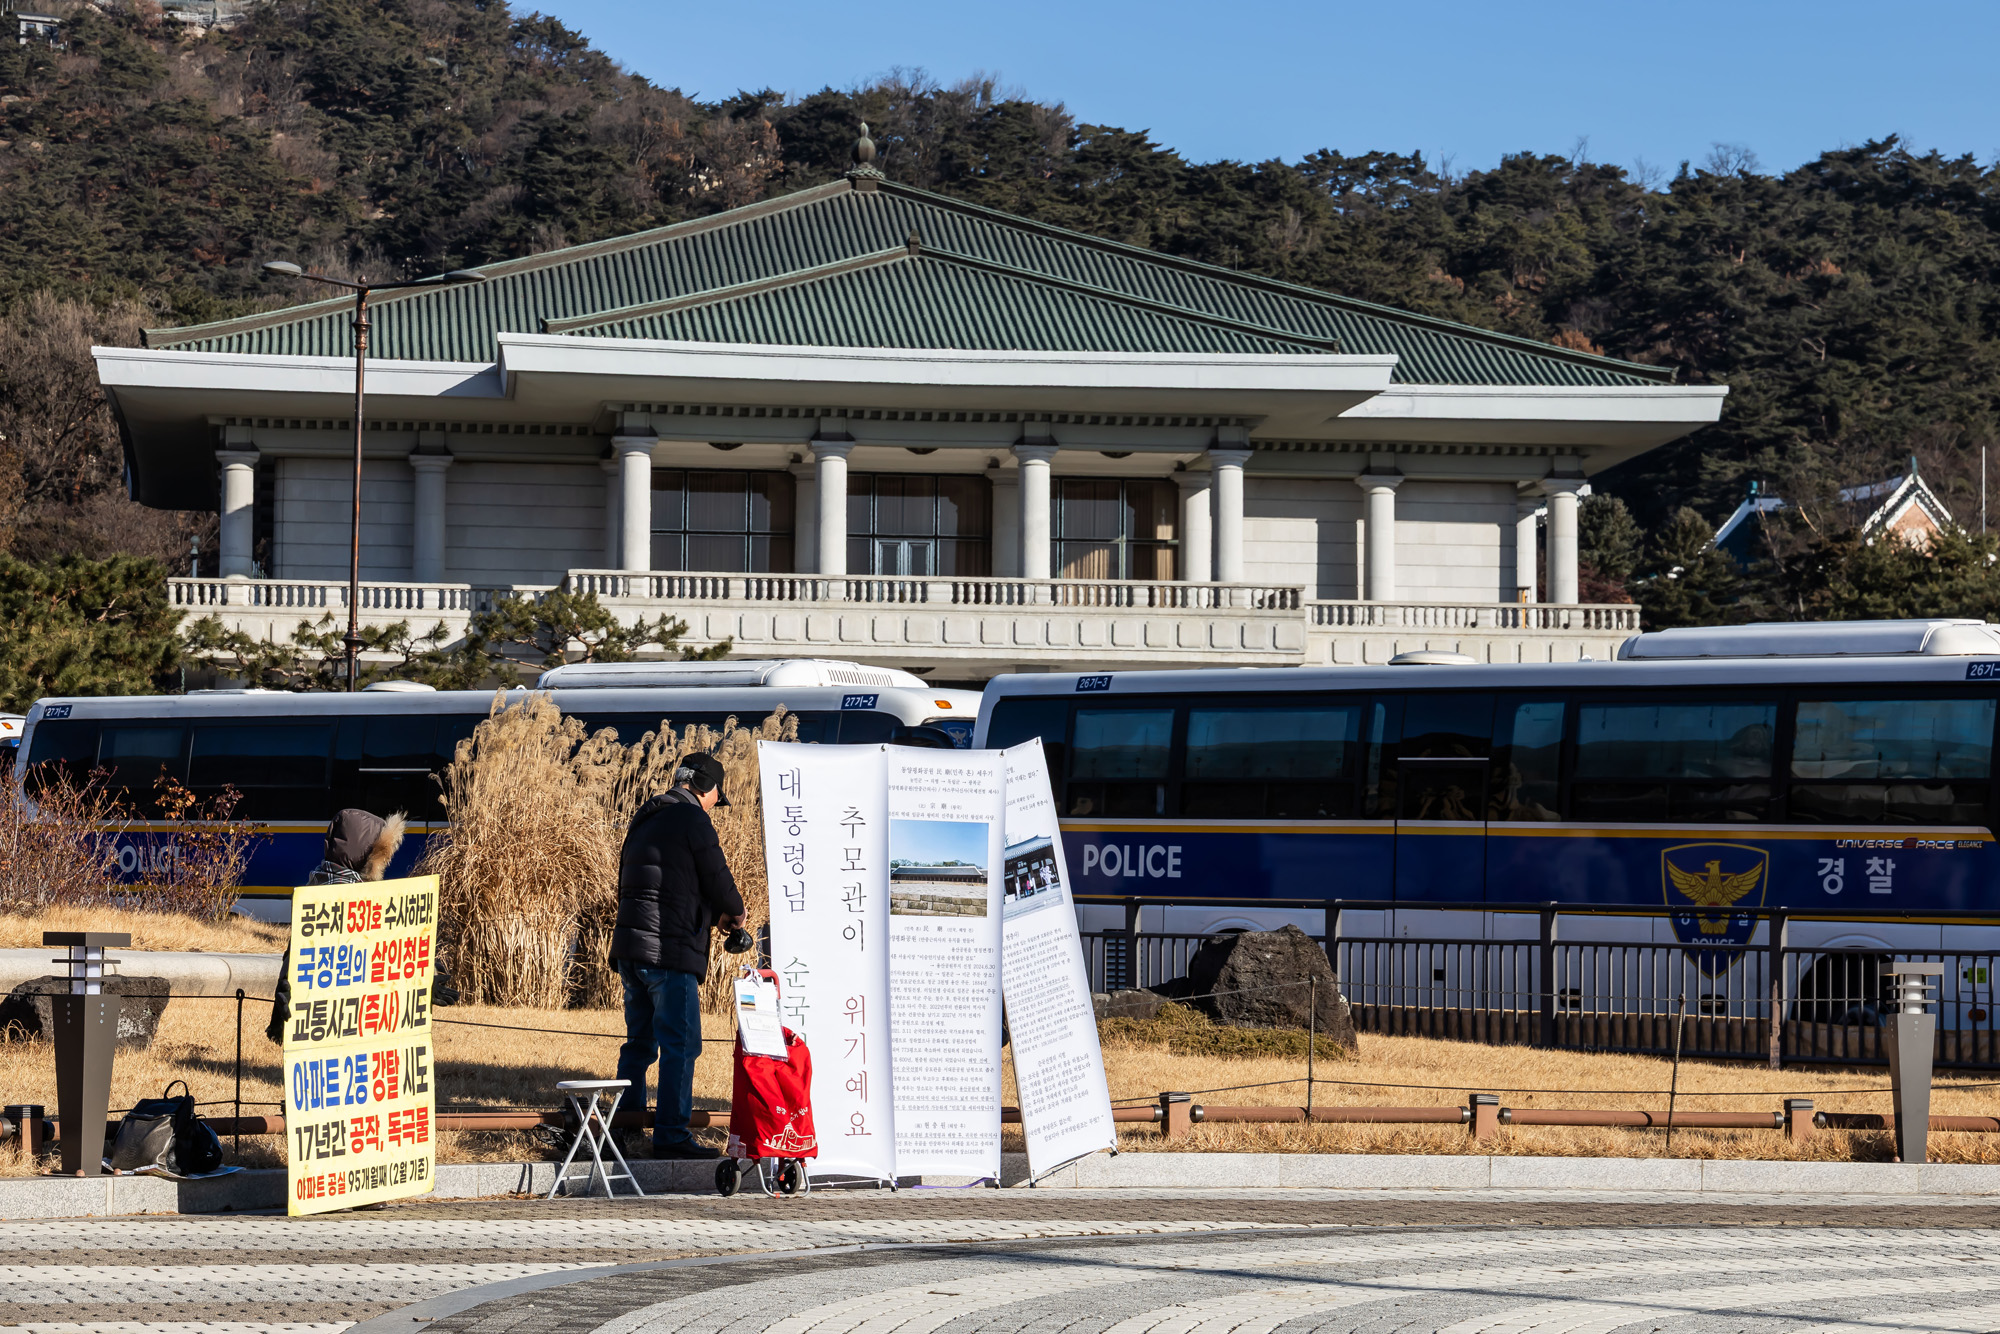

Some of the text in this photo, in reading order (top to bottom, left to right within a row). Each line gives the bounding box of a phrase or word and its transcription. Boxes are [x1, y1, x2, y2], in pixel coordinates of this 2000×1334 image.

[844, 696, 875, 708] 27기-2
[1079, 676, 1108, 689] 26기-3
[1083, 844, 1182, 878] POLICE
[1836, 839, 1904, 849] UNIVERSE
[1957, 840, 1983, 849] ELEGANCE
[301, 892, 433, 937] 공수처 531호 수사하라!
[778, 767, 810, 1047] 대통령님 순국
[297, 935, 430, 990] 국정원의 살인청부
[839, 806, 872, 1136] 추모관이 위기예요
[292, 988, 427, 1042] 교통사고(즉사) 시도
[293, 1046, 428, 1112] 아파트 2동 강탈 시도
[295, 1106, 429, 1161] 17년간 공작, 독극물
[297, 1156, 429, 1201] 아파트 공실 95개월째 (2월 기준)
